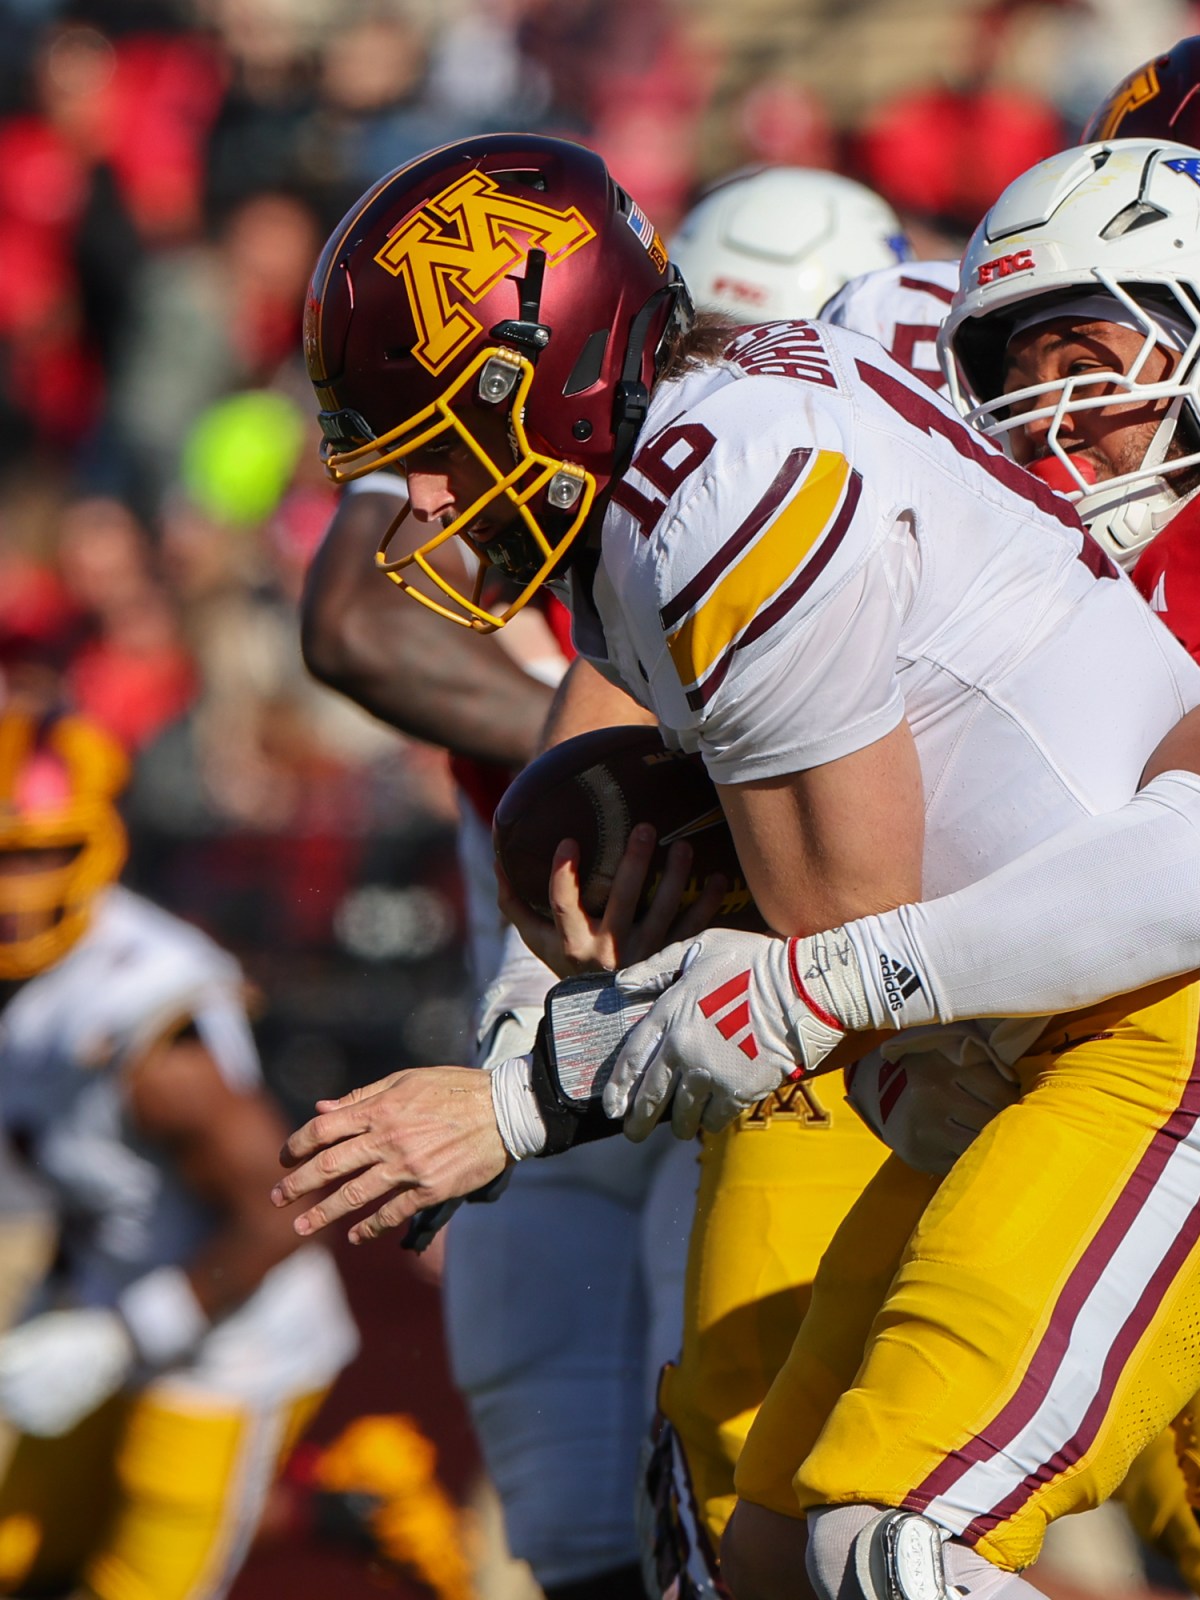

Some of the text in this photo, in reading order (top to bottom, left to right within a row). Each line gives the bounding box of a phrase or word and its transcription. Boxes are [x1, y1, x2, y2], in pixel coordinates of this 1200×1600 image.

[373, 168, 597, 377] M
[610, 410, 718, 541] 16
[879, 953, 904, 1012] adidas
